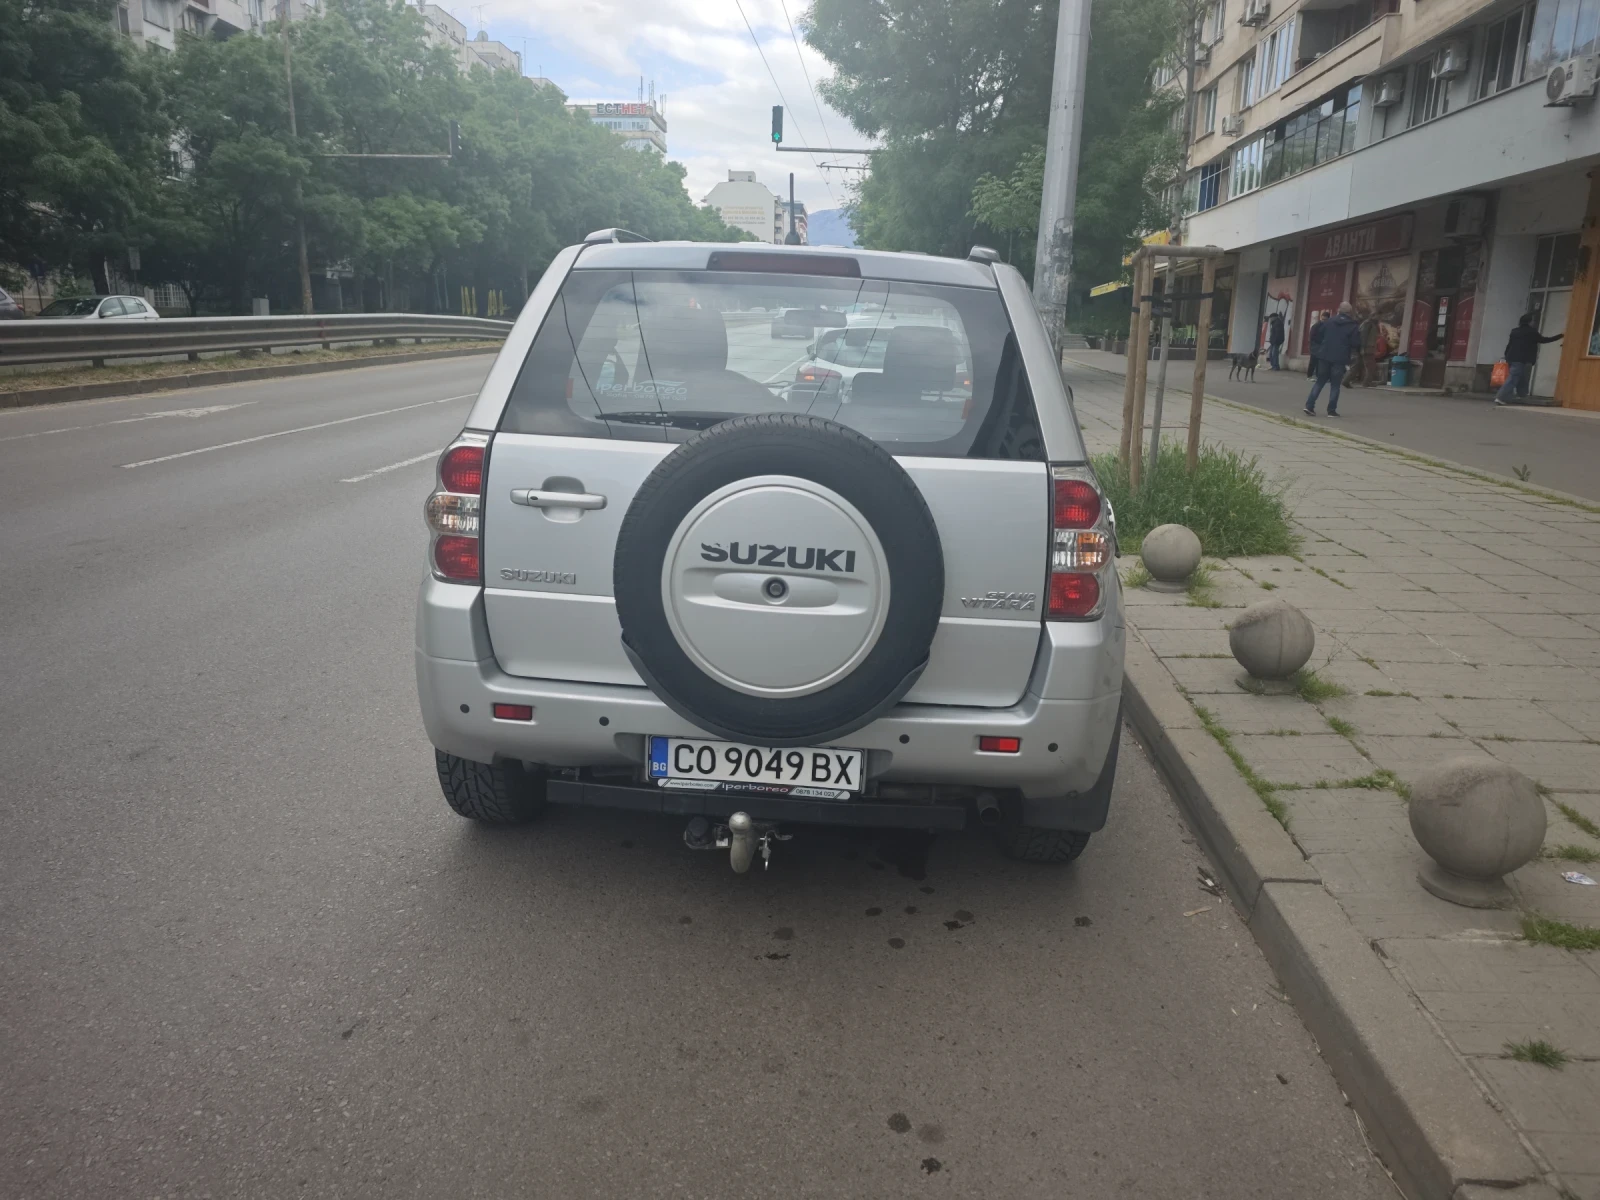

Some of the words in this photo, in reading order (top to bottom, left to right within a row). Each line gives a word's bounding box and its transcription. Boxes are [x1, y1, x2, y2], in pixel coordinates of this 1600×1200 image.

[1324, 227, 1377, 259] АВАНТИ
[700, 541, 856, 573] SUZUKI
[500, 567, 577, 585] SUZUKI
[961, 597, 1036, 611] VITARA
[986, 591, 1037, 600] GRAND
[652, 761, 667, 772] BG
[724, 746, 804, 780] 9049
